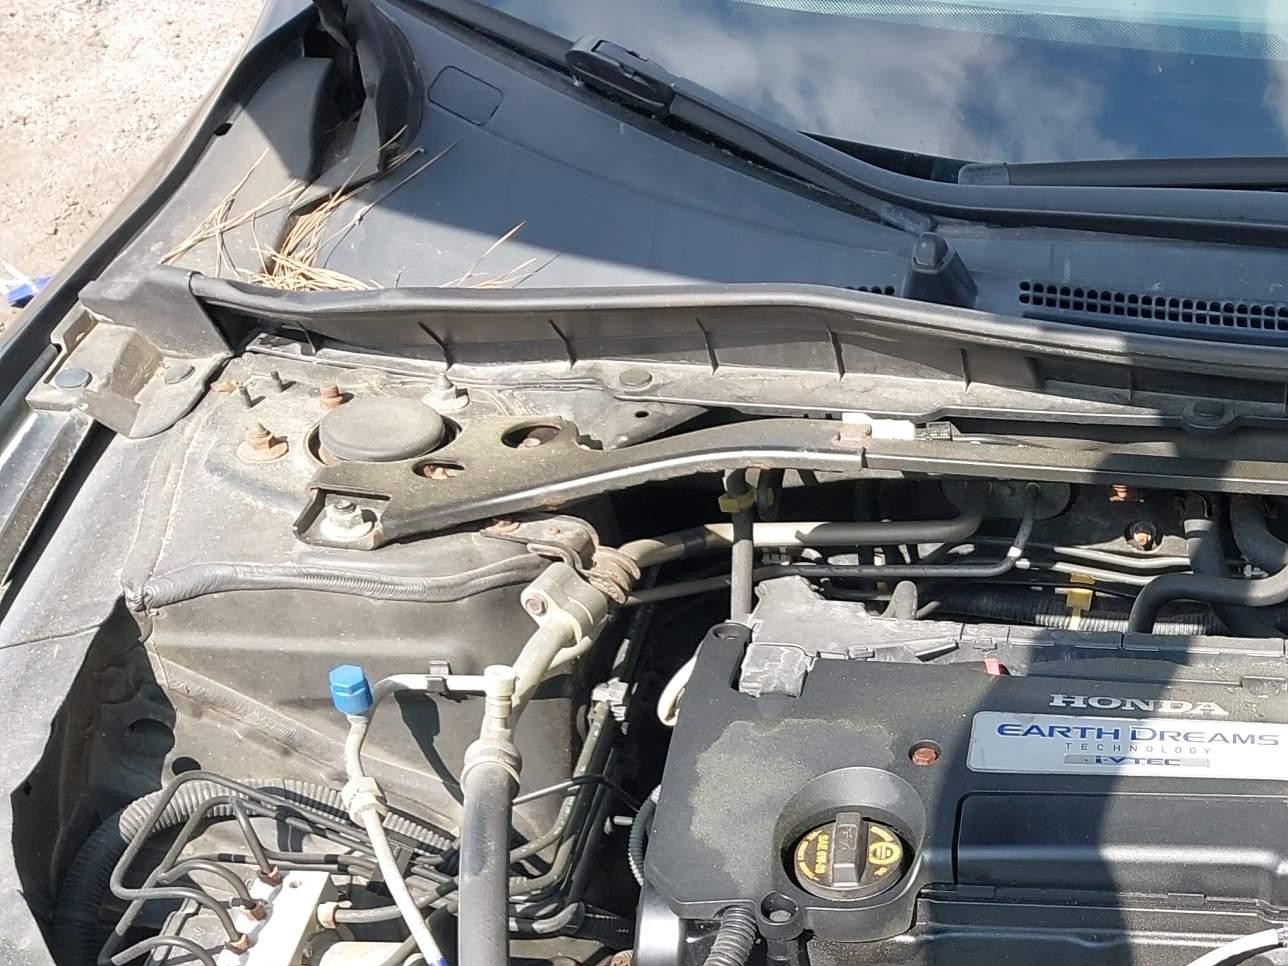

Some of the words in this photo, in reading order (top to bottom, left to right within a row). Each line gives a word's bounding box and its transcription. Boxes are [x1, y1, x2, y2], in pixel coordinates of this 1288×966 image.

[1049, 693, 1229, 716] HONDA
[996, 722, 1121, 742] EARTH
[1129, 724, 1281, 748] DREAMS
[1065, 741, 1213, 756] TECHNOLOGY
[1095, 755, 1182, 766] i-VTEC
